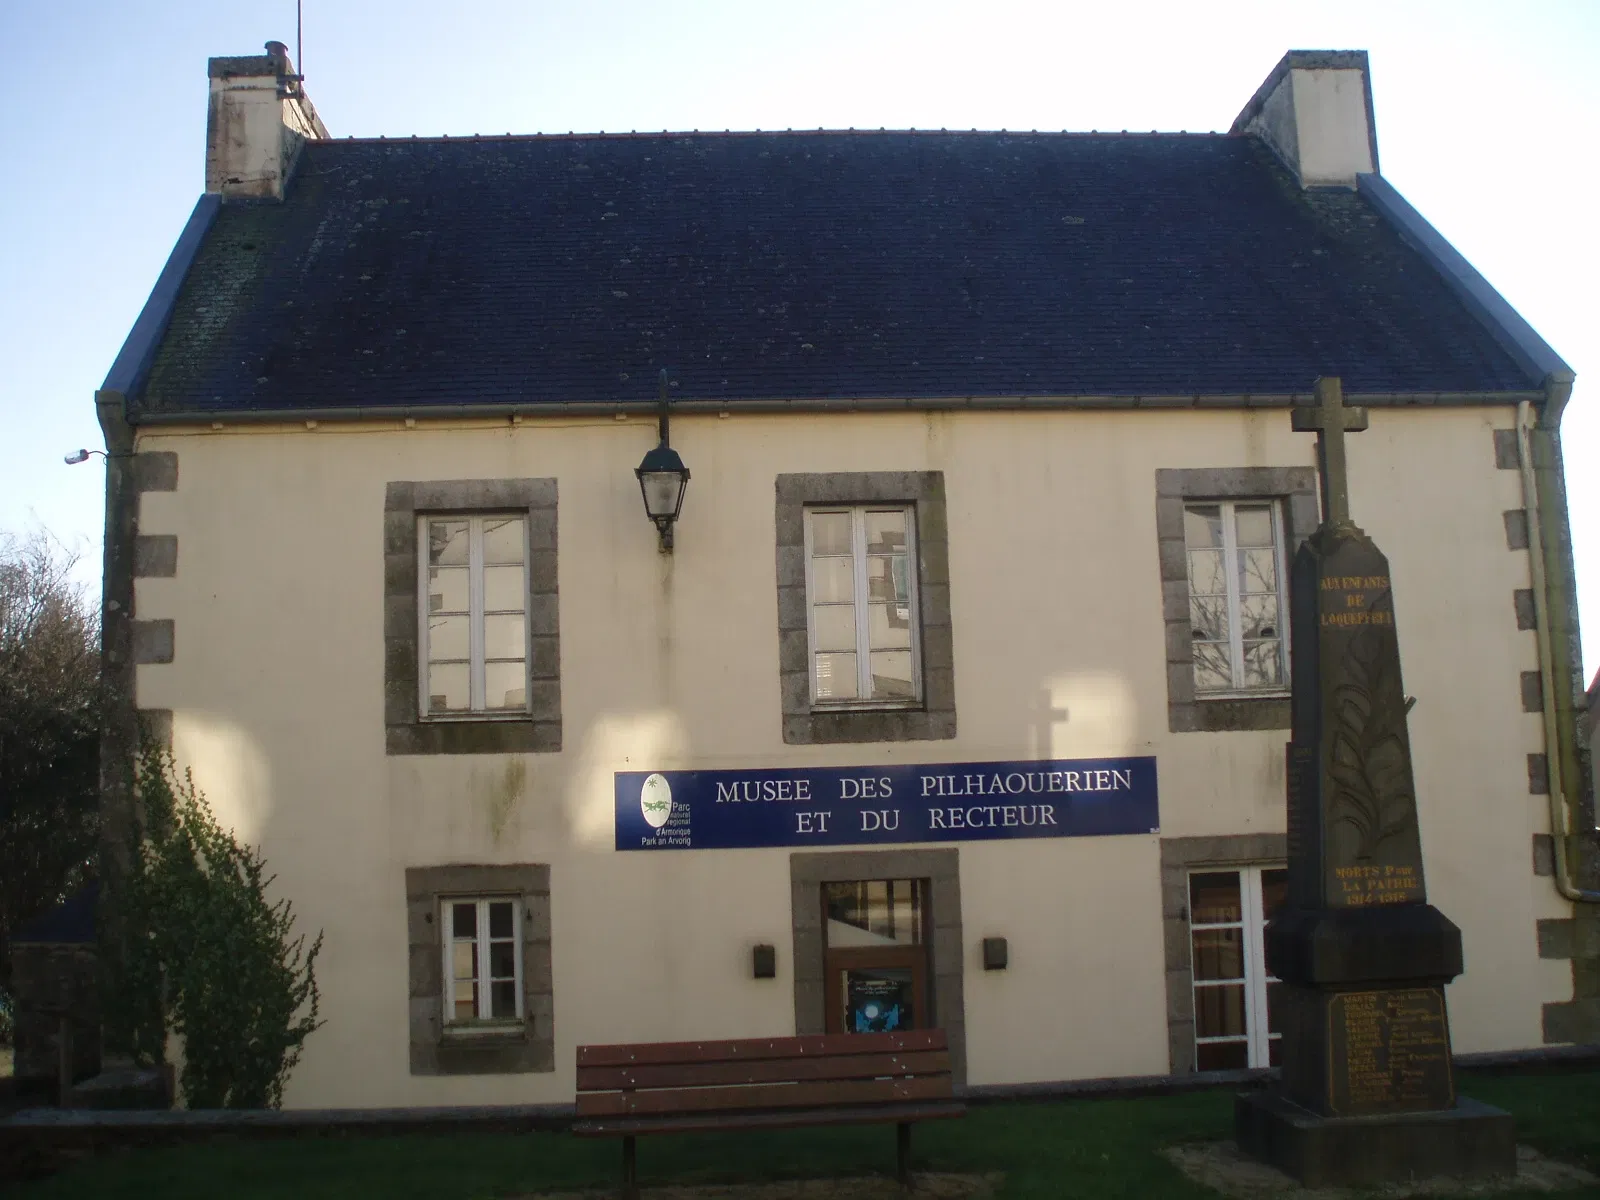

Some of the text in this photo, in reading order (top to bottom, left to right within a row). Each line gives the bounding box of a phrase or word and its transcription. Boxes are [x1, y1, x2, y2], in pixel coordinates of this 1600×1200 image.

[1346, 593, 1364, 606] DE
[716, 770, 1131, 802] MUSEE DES PILHAOUERIEN
[672, 801, 690, 811] Parc
[796, 805, 1057, 832] ET DU RECTEUR
[641, 836, 691, 847] Park an Arvorig
[1336, 866, 1380, 879] MORTS
[1342, 880, 1361, 891] LA
